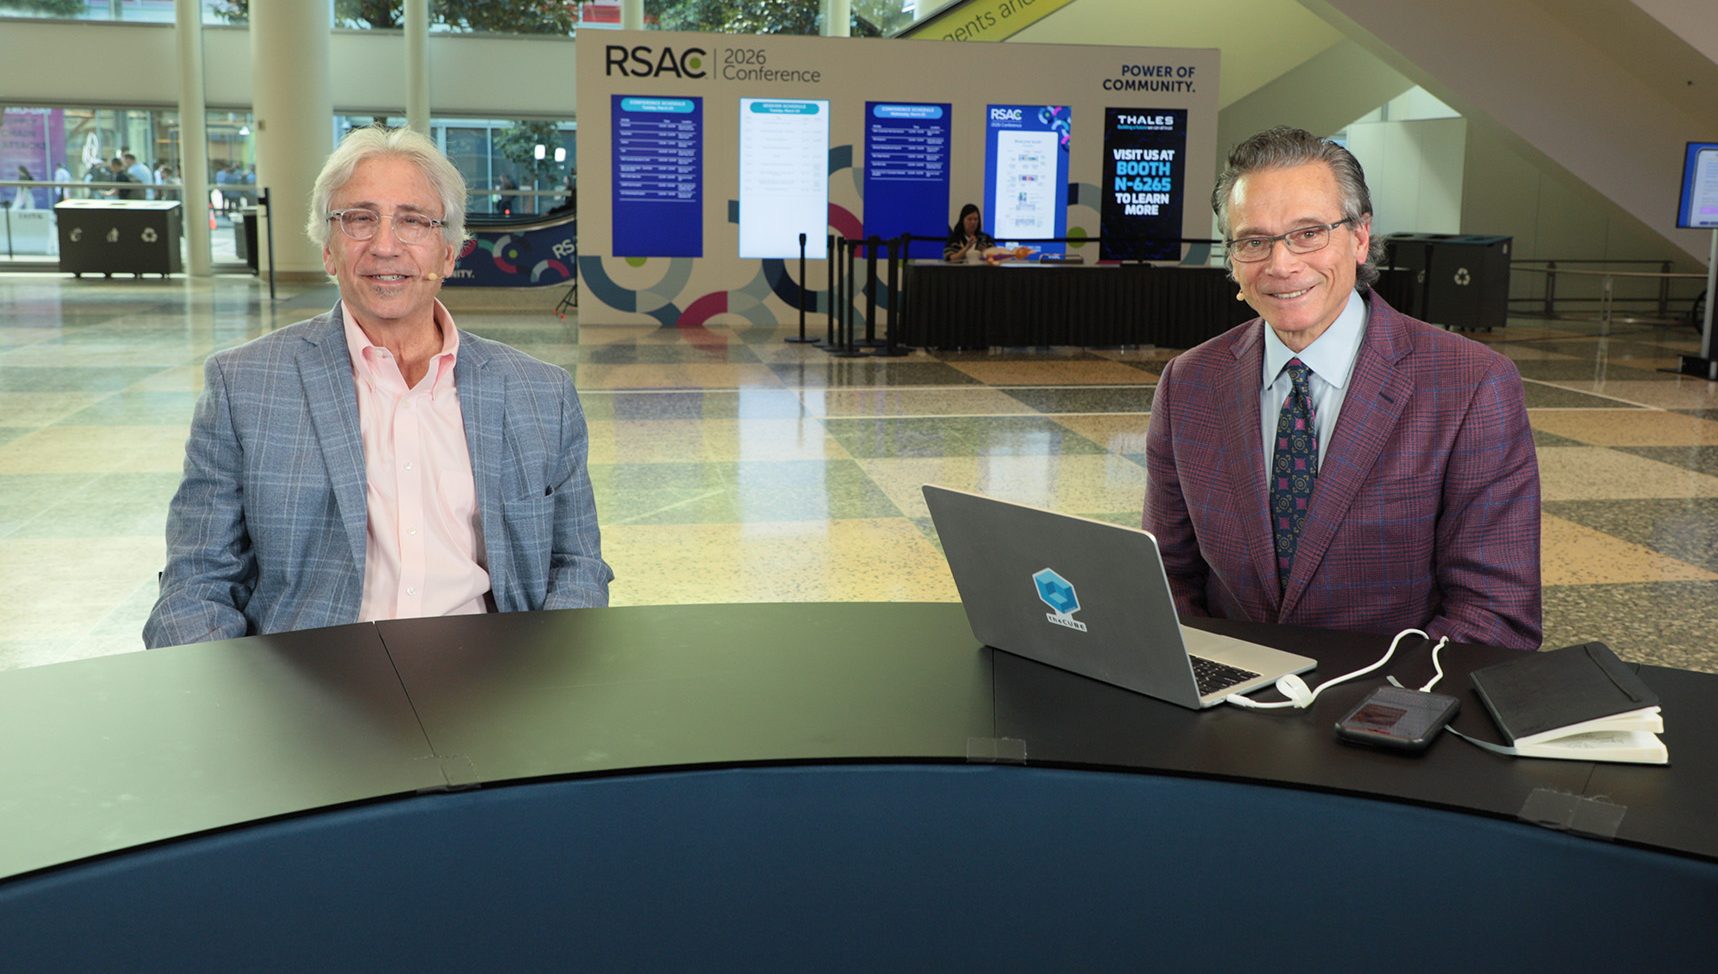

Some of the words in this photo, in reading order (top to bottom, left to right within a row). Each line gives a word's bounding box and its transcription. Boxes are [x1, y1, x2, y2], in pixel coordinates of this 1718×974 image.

[605, 45, 707, 79] RSAC
[724, 48, 767, 65] 2026
[722, 65, 821, 82] Conference
[1121, 65, 1172, 77] POWER
[1176, 66, 1196, 78] OF
[1102, 78, 1196, 93] COMMUNITY.
[991, 108, 1023, 121] RSAC
[1117, 115, 1174, 125] THALES
[1113, 149, 1143, 160] VISIT
[1143, 149, 1159, 161] US
[1160, 150, 1175, 161] AT
[1116, 161, 1171, 176] BOOTH
[1114, 176, 1171, 192] N-6265
[1115, 193, 1131, 204] TO
[1131, 193, 1170, 204] LEARN
[1124, 204, 1159, 215] MORE
[551, 238, 576, 260] RS
